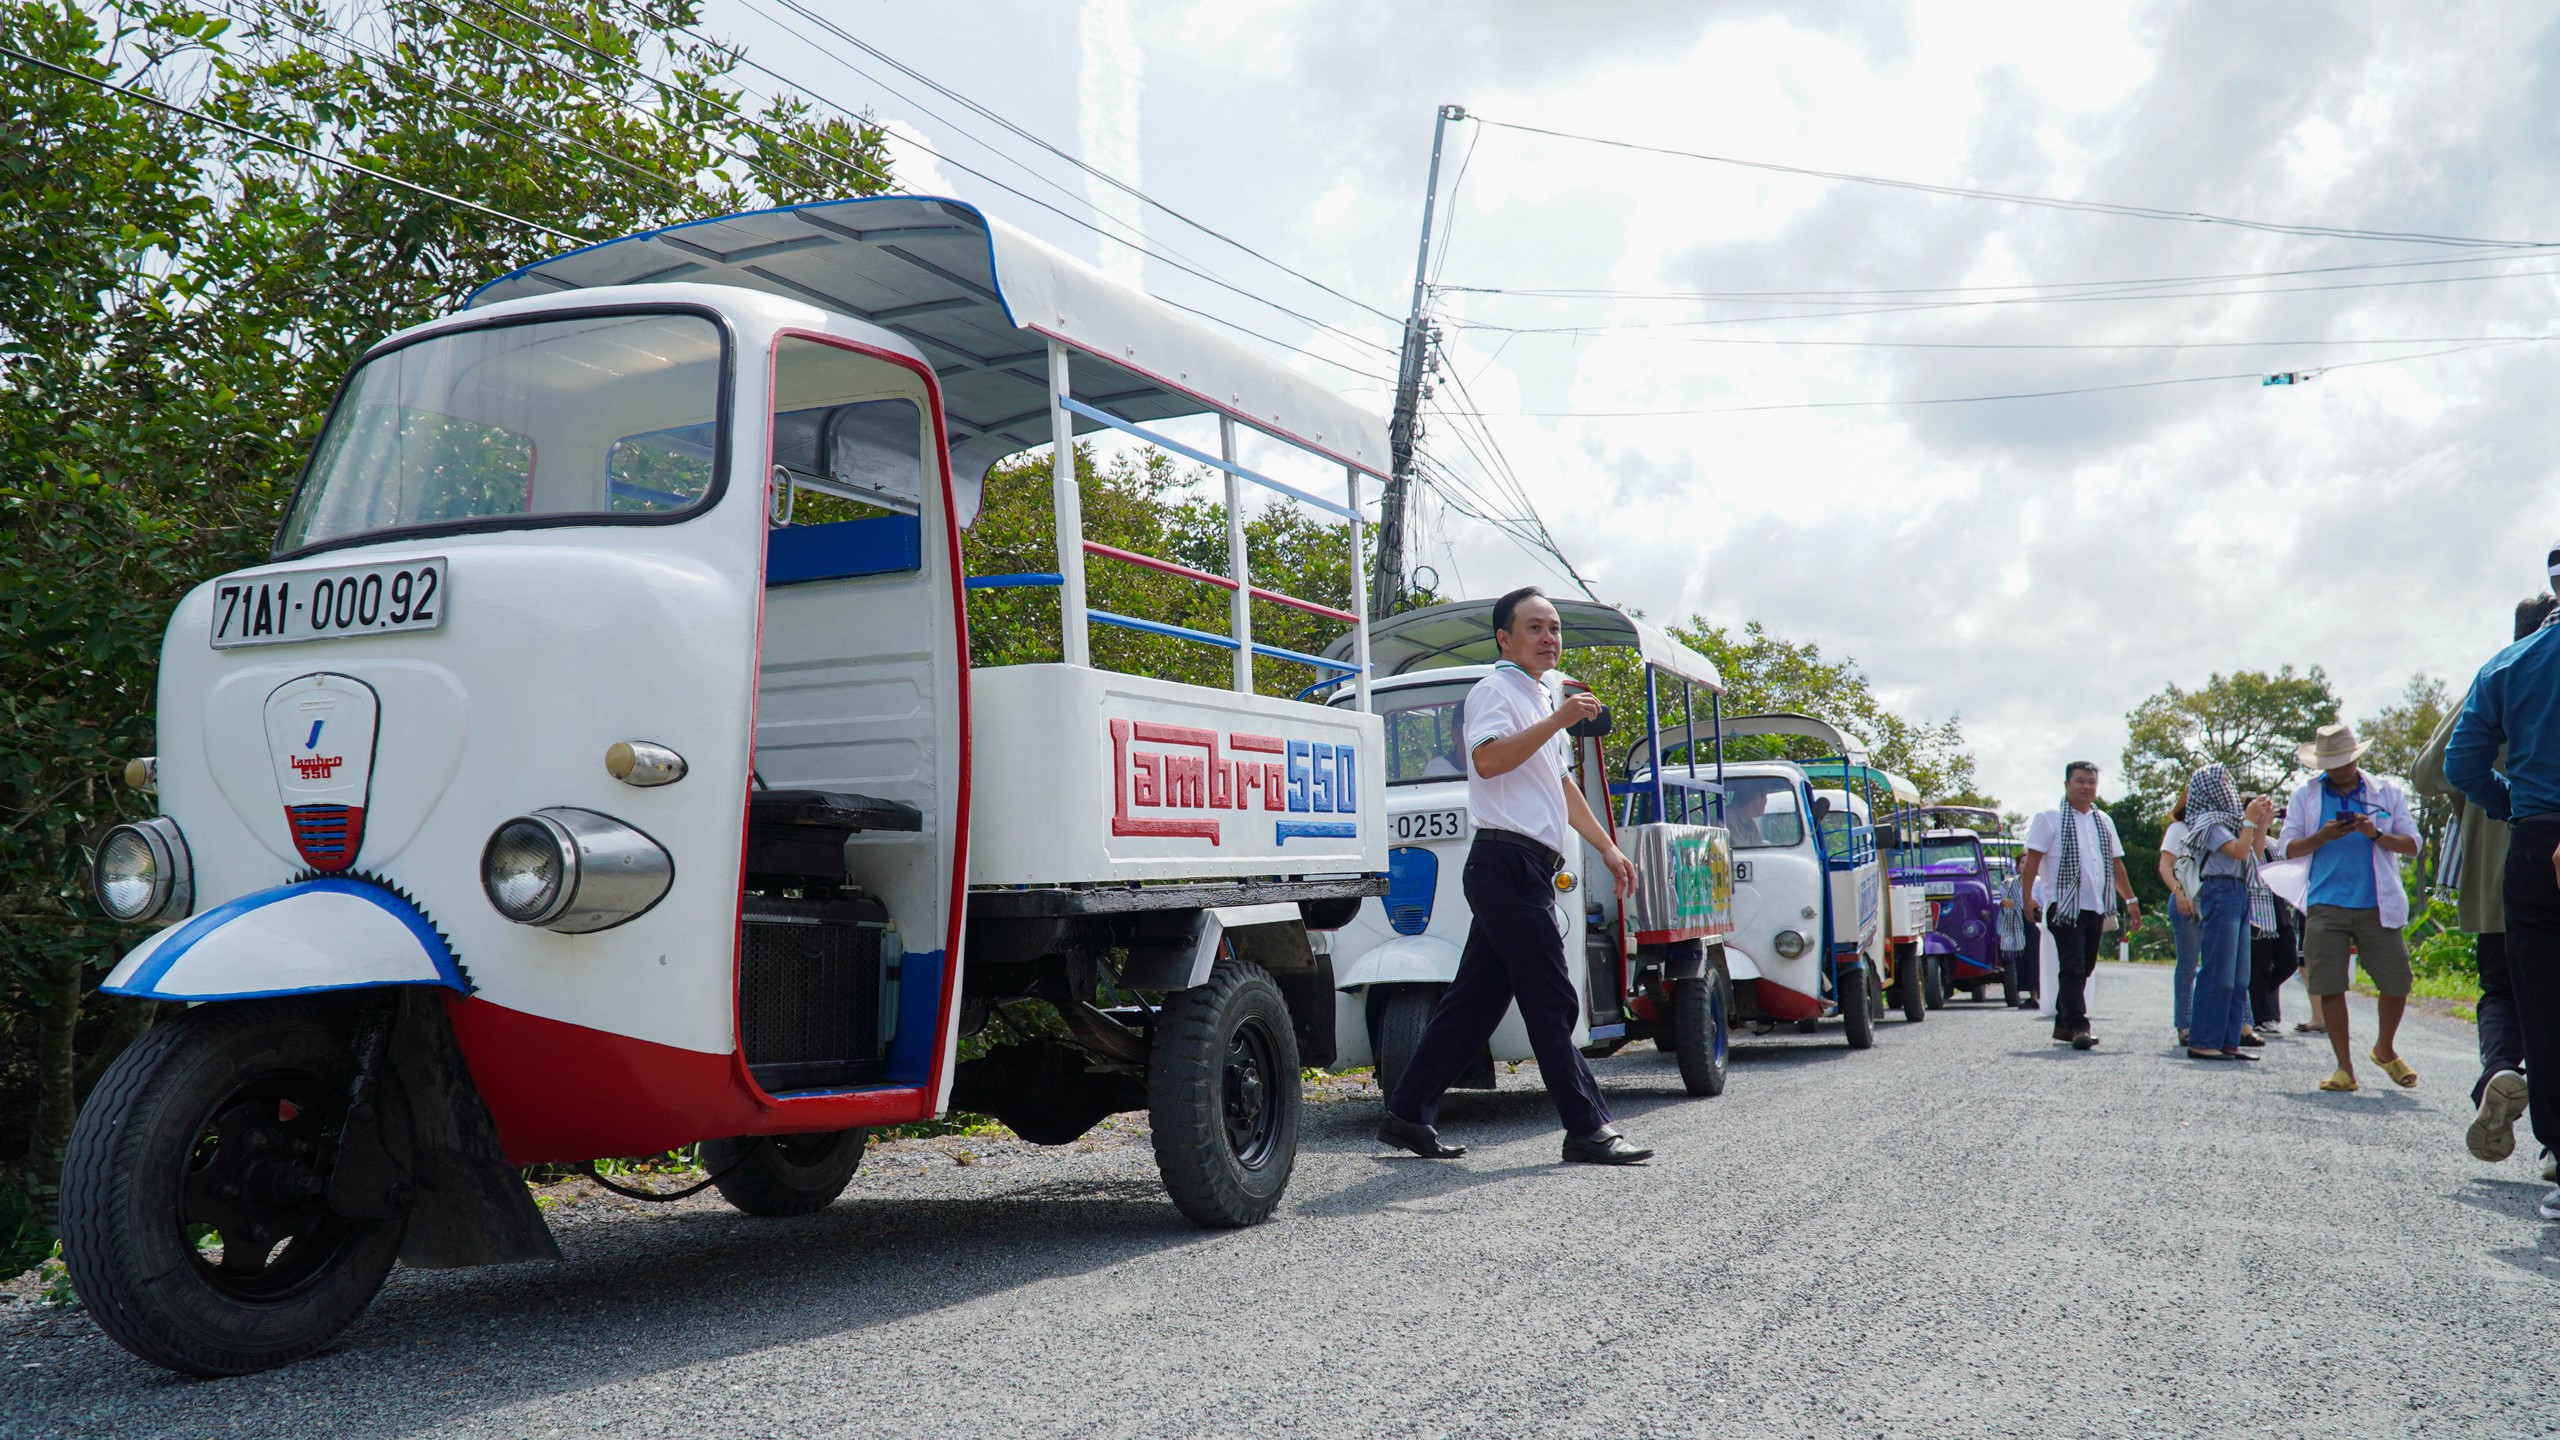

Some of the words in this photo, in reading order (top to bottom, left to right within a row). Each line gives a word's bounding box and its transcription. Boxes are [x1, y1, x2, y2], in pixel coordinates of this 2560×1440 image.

[217, 567, 438, 638] 71A1-000.92
[301, 767, 331, 780] 550
[1287, 739, 1356, 813] 550
[1736, 862, 1747, 879] 6
